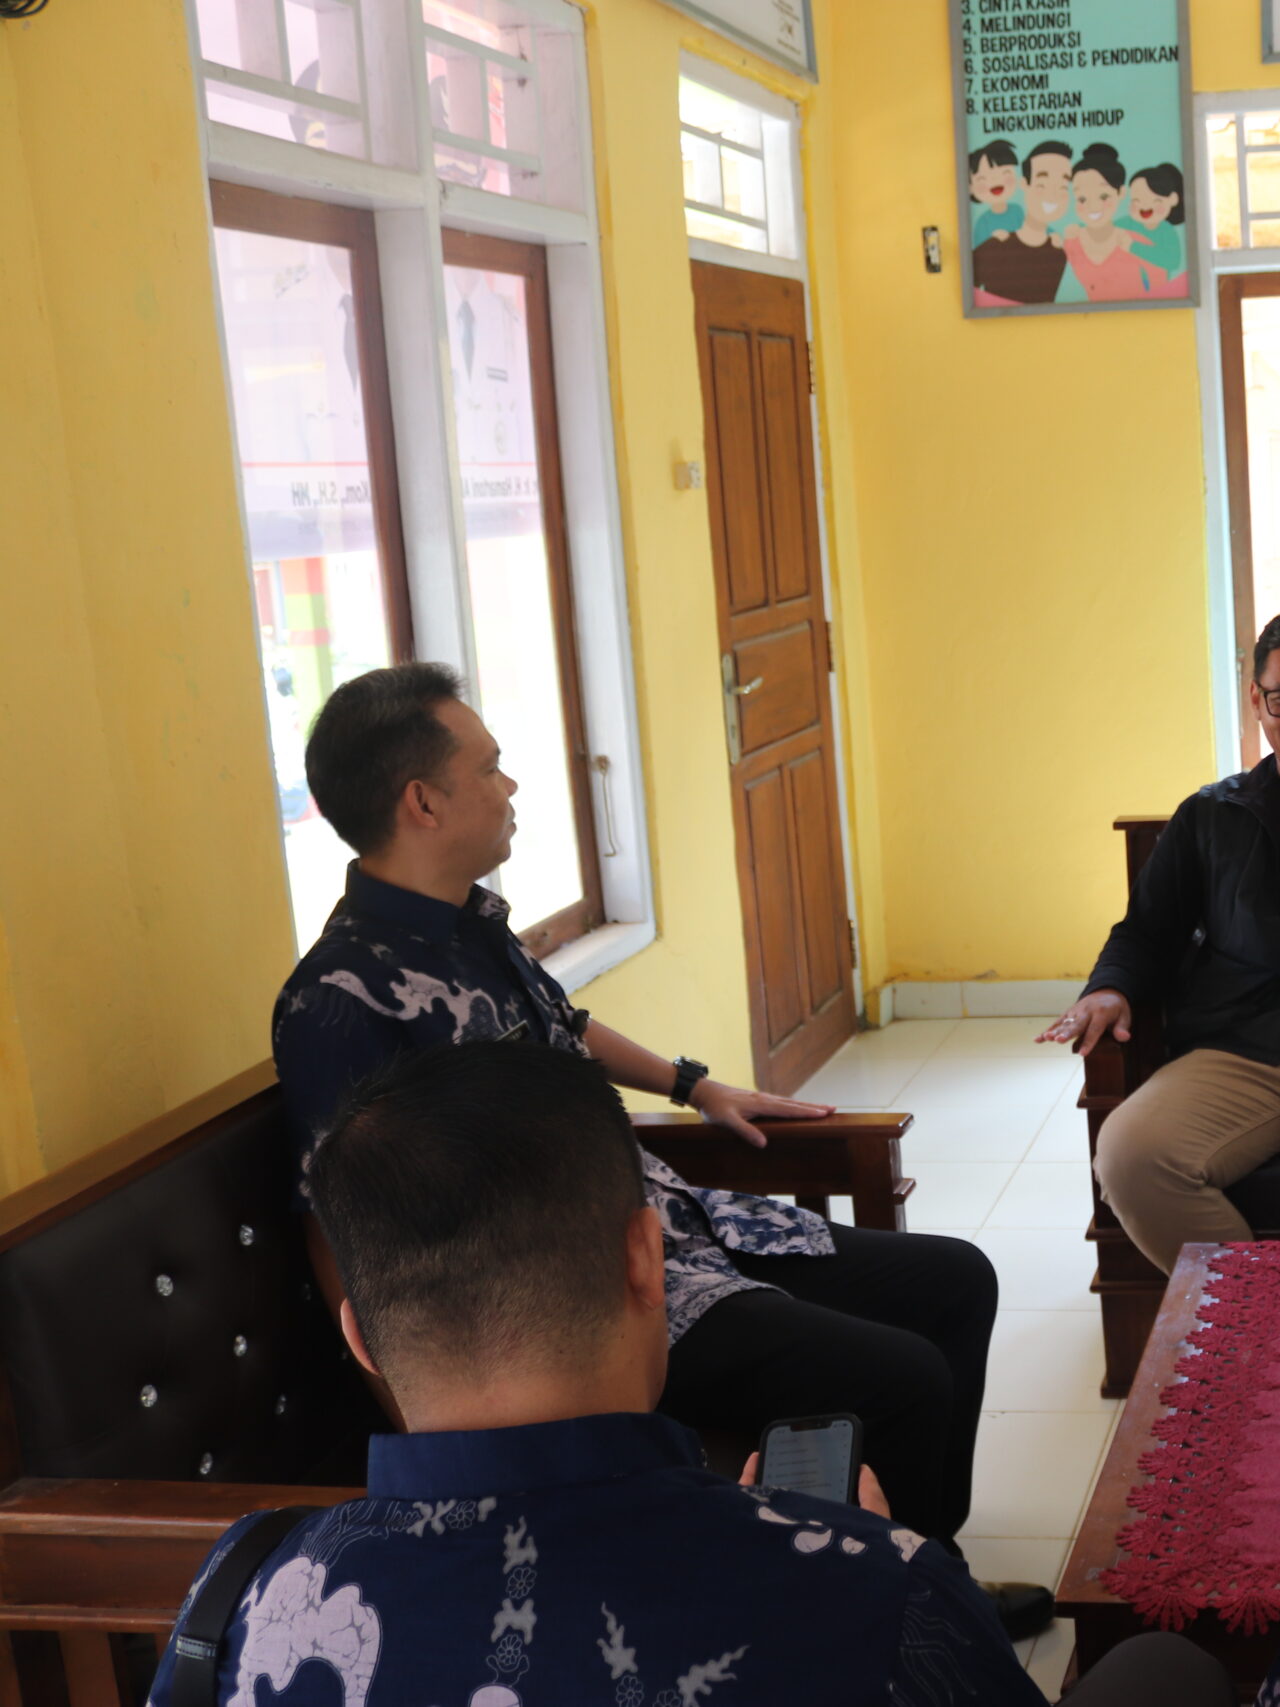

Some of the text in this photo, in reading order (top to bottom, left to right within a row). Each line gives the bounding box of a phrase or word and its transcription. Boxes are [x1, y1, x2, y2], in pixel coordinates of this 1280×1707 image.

[979, 0, 1022, 13] CINTA
[962, 13, 1071, 35] 4. MELINDUNGI
[963, 32, 1081, 55] 5. BERPRODUKSI
[964, 45, 1179, 75] 6. SOSIALISASI & PENDIDIKAN
[965, 75, 1049, 95] 7. EKONOMI
[966, 92, 1082, 115] 8. KELESTARIAN
[983, 109, 1124, 134] LINGKUNGAN HIDUP
